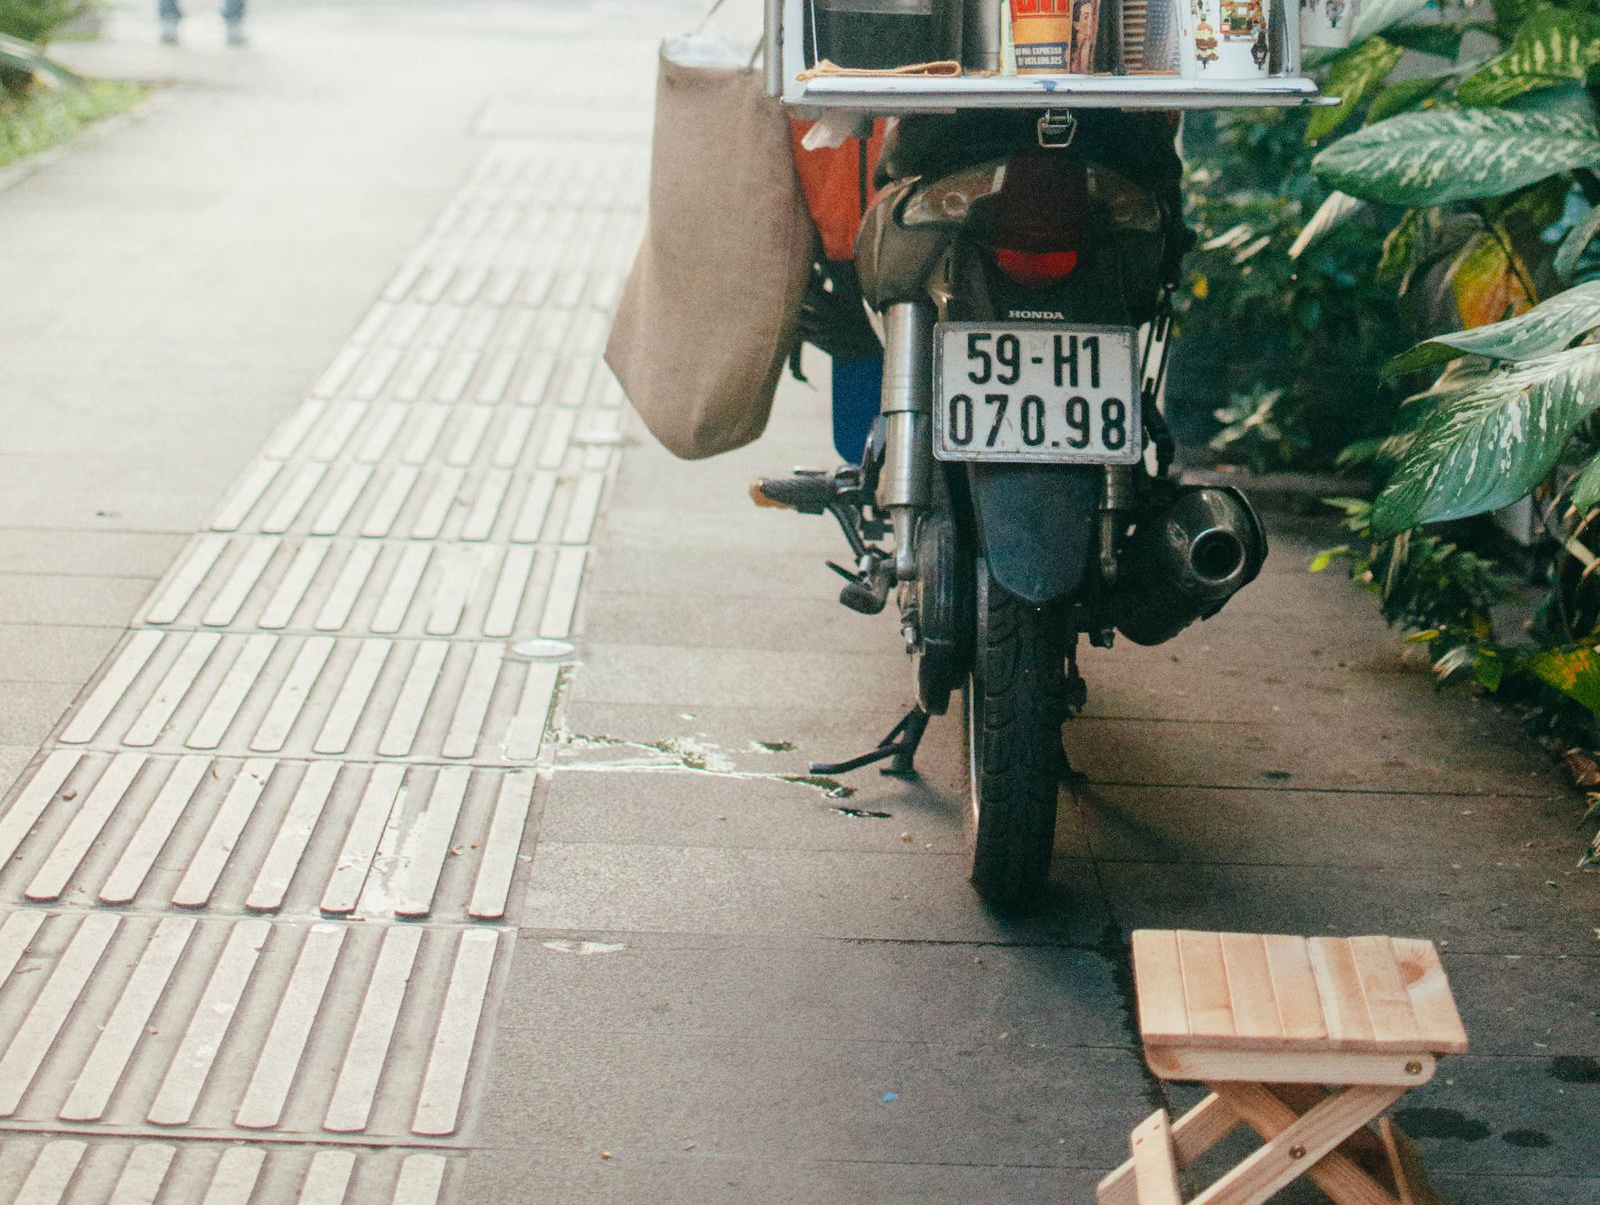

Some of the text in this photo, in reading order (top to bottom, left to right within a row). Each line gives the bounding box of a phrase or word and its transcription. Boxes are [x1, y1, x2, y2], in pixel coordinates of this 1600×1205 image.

[1008, 310, 1065, 320] HONDA
[967, 333, 1100, 388] 59-H1
[949, 394, 1127, 451] 070.98
